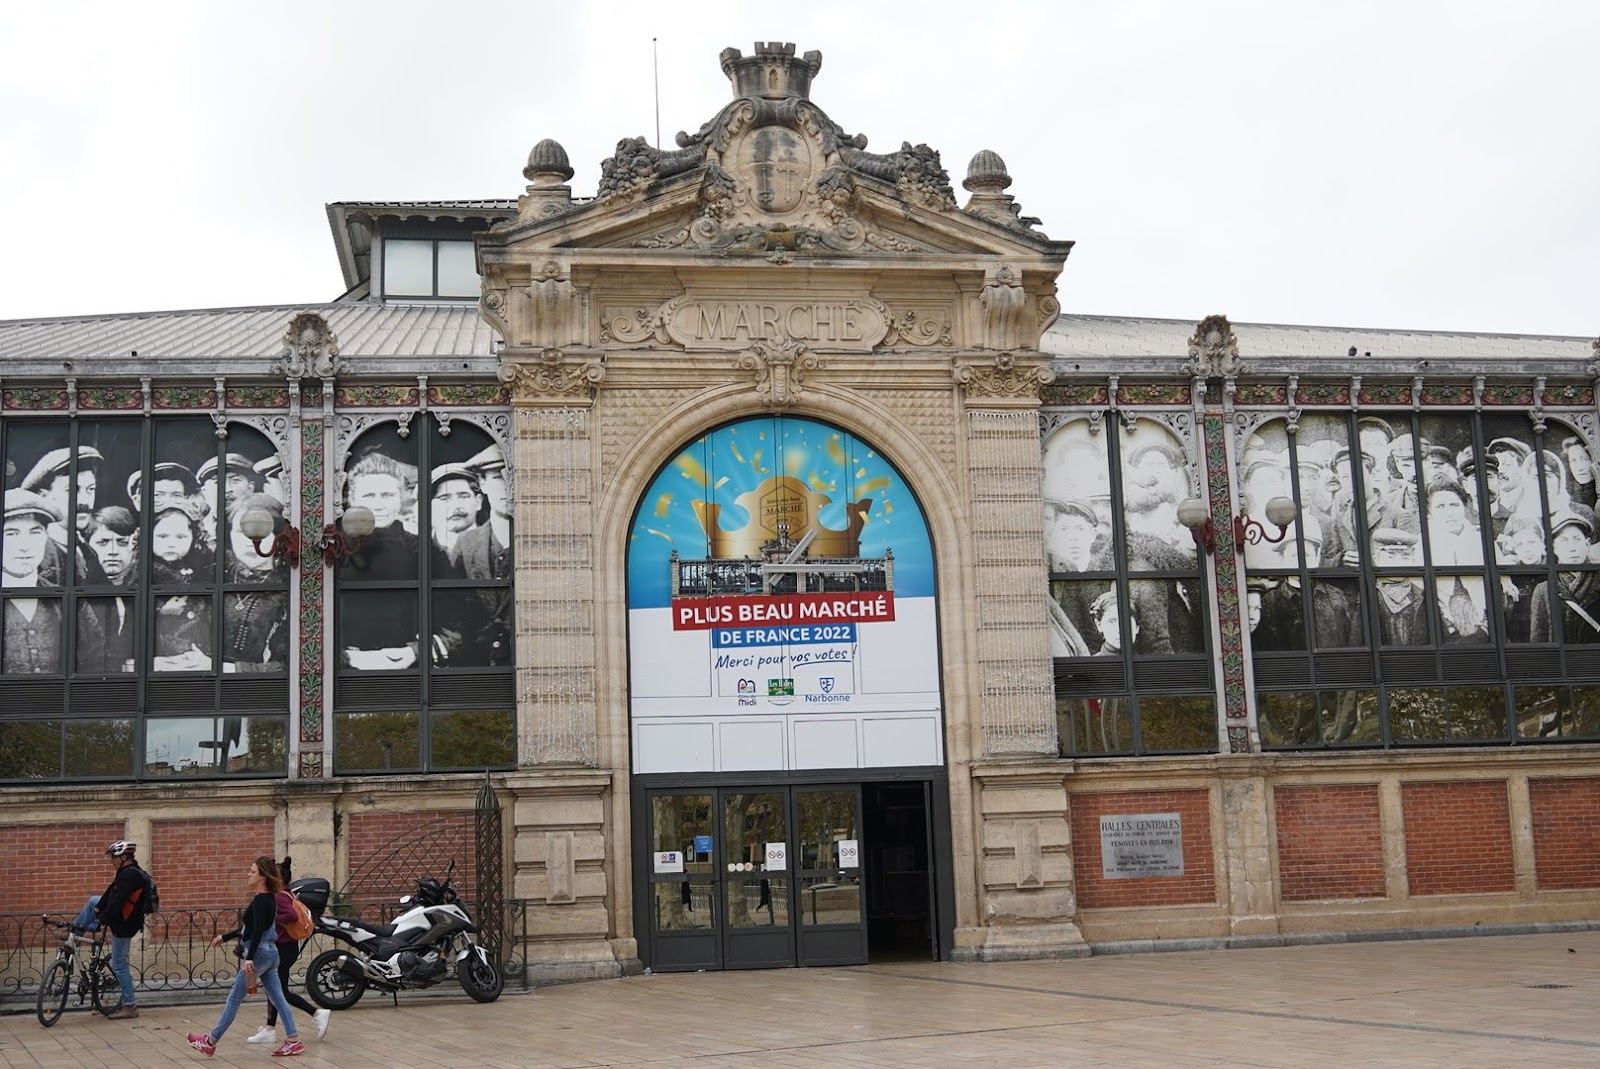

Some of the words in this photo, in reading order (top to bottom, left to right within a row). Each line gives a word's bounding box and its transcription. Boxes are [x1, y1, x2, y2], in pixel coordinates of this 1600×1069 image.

[680, 606, 733, 624] PLUS
[739, 603, 793, 621] BEAU
[800, 595, 888, 619] MARCHÉ
[720, 631, 742, 644] DE
[746, 628, 810, 643] FRANCE
[814, 626, 851, 640] 2022
[715, 655, 754, 669] Merci
[757, 656, 787, 669] pour
[790, 653, 811, 662] vos
[815, 648, 848, 660] votes
[805, 694, 851, 702] Narbonne
[1102, 821, 1132, 831] HALLES
[1136, 820, 1180, 830] CENTRALES
